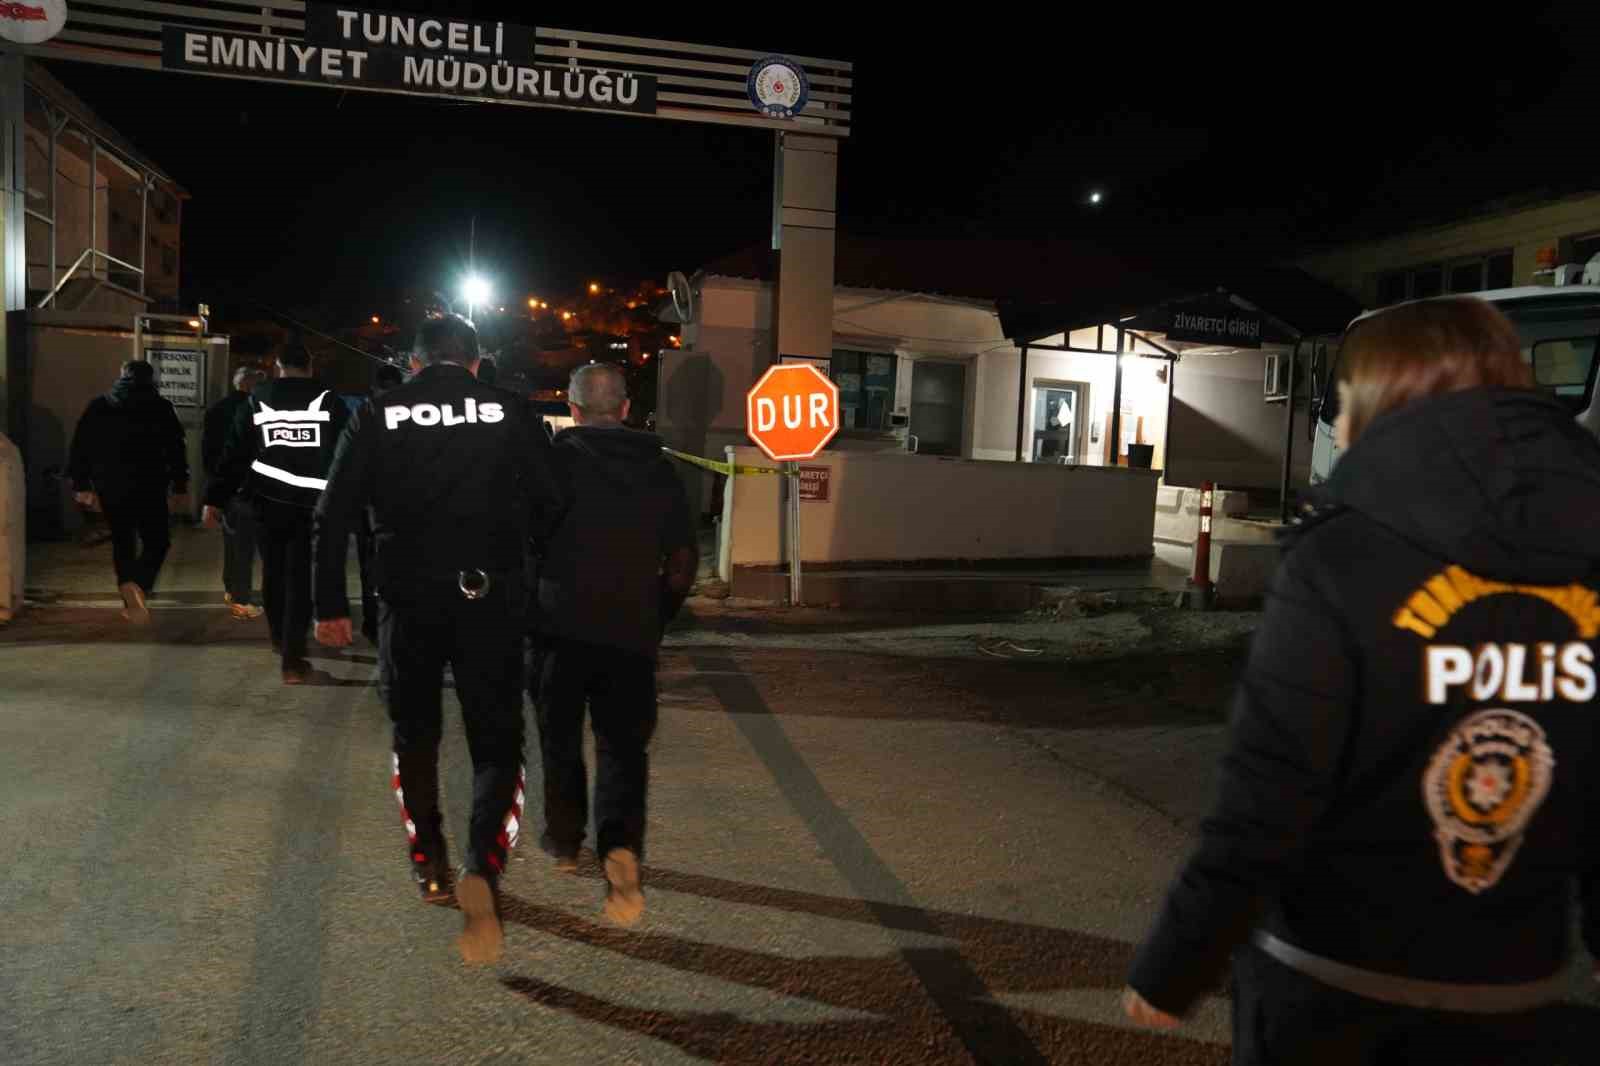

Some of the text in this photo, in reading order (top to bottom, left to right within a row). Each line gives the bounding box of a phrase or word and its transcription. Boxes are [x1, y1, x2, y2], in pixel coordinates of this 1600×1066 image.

[336, 9, 504, 55] TUNCELİ
[184, 32, 639, 105] EMNİYET MÜDÜRLÜĞÜ
[383, 397, 505, 430] POLİS
[756, 392, 830, 432] DUR
[272, 427, 311, 441] POLİS
